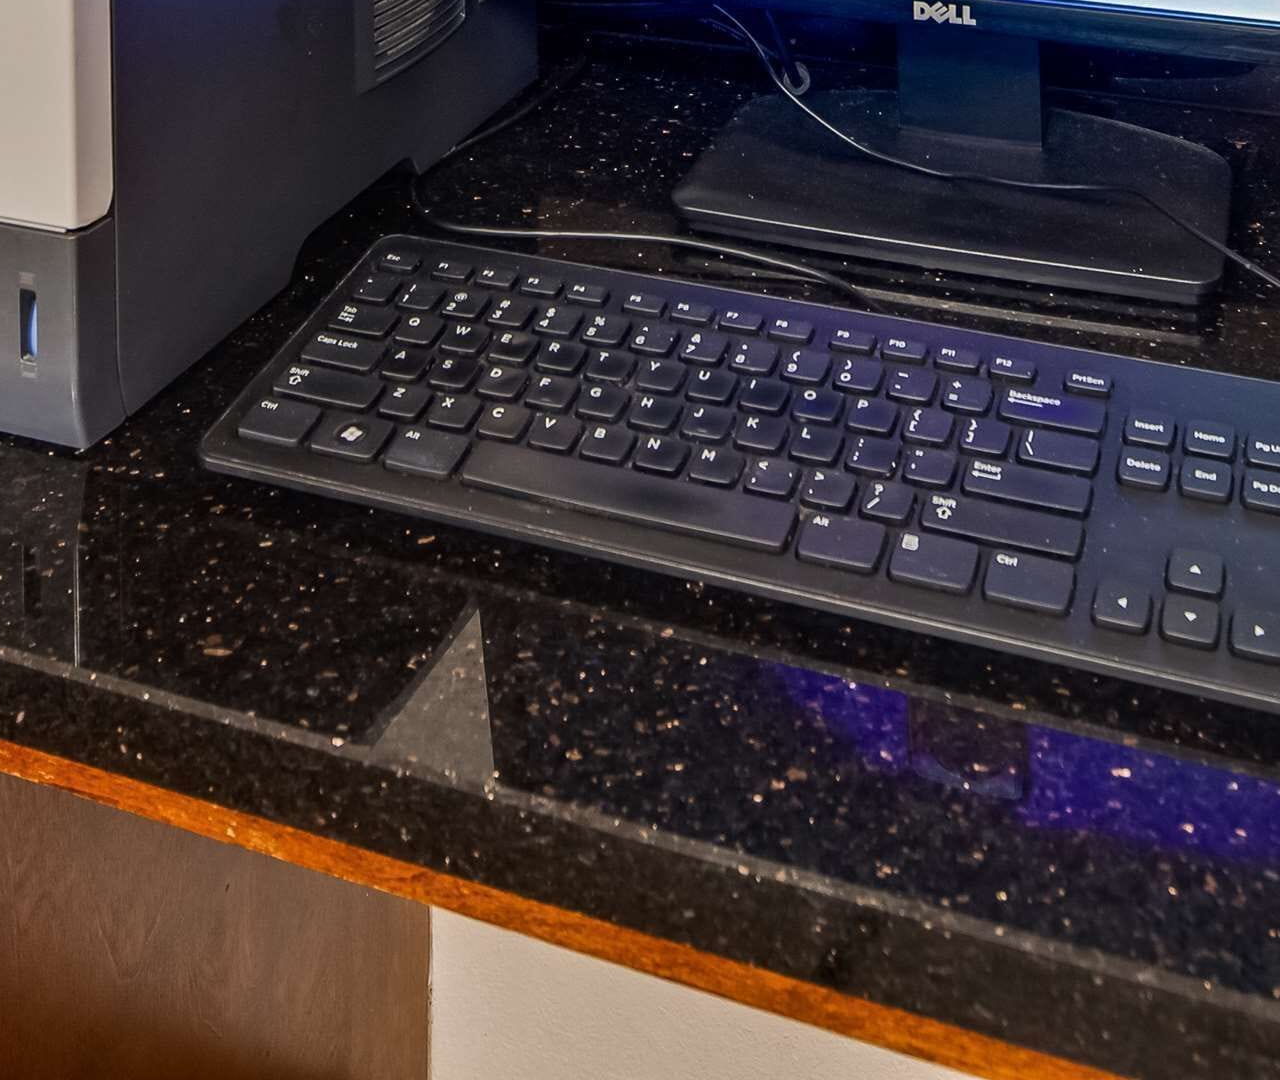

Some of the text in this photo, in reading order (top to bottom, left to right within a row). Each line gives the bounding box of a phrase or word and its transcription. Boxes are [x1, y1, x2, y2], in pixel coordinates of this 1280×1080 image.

[913, 0, 977, 26] DELL
[409, 318, 420, 326] Q
[457, 325, 471, 335] W
[318, 335, 358, 348] Caps Lock
[501, 334, 512, 343] E
[549, 342, 560, 352] R
[395, 351, 405, 359] A
[600, 352, 609, 361] T
[443, 360, 453, 368] S
[651, 361, 660, 370] Y
[289, 366, 310, 377] Shift
[490, 368, 502, 377] D
[699, 370, 710, 380] U
[540, 378, 551, 386] F
[393, 388, 405, 397] Z
[591, 388, 601, 397] G
[804, 390, 816, 400] O
[442, 397, 454, 408] X
[641, 397, 653, 408] H
[1009, 390, 1061, 406] Backspace
[262, 401, 278, 410] Ctrl
[858, 399, 868, 408] P
[493, 408, 504, 417] C
[694, 408, 704, 417] J
[546, 418, 556, 428] V
[747, 417, 759, 428] K
[1135, 420, 1163, 432] Insert
[594, 428, 606, 438] B
[802, 428, 810, 439] L
[1194, 431, 1225, 443] Home
[648, 438, 660, 449] N
[1256, 442, 1270, 452] Pg
[702, 449, 715, 461] M
[972, 461, 1001, 476] Enter
[1127, 458, 1161, 471] Delete
[1195, 470, 1216, 480] End
[1253, 481, 1268, 492] Pg
[932, 495, 957, 508] Shift
[997, 554, 1017, 566] Ctrl
